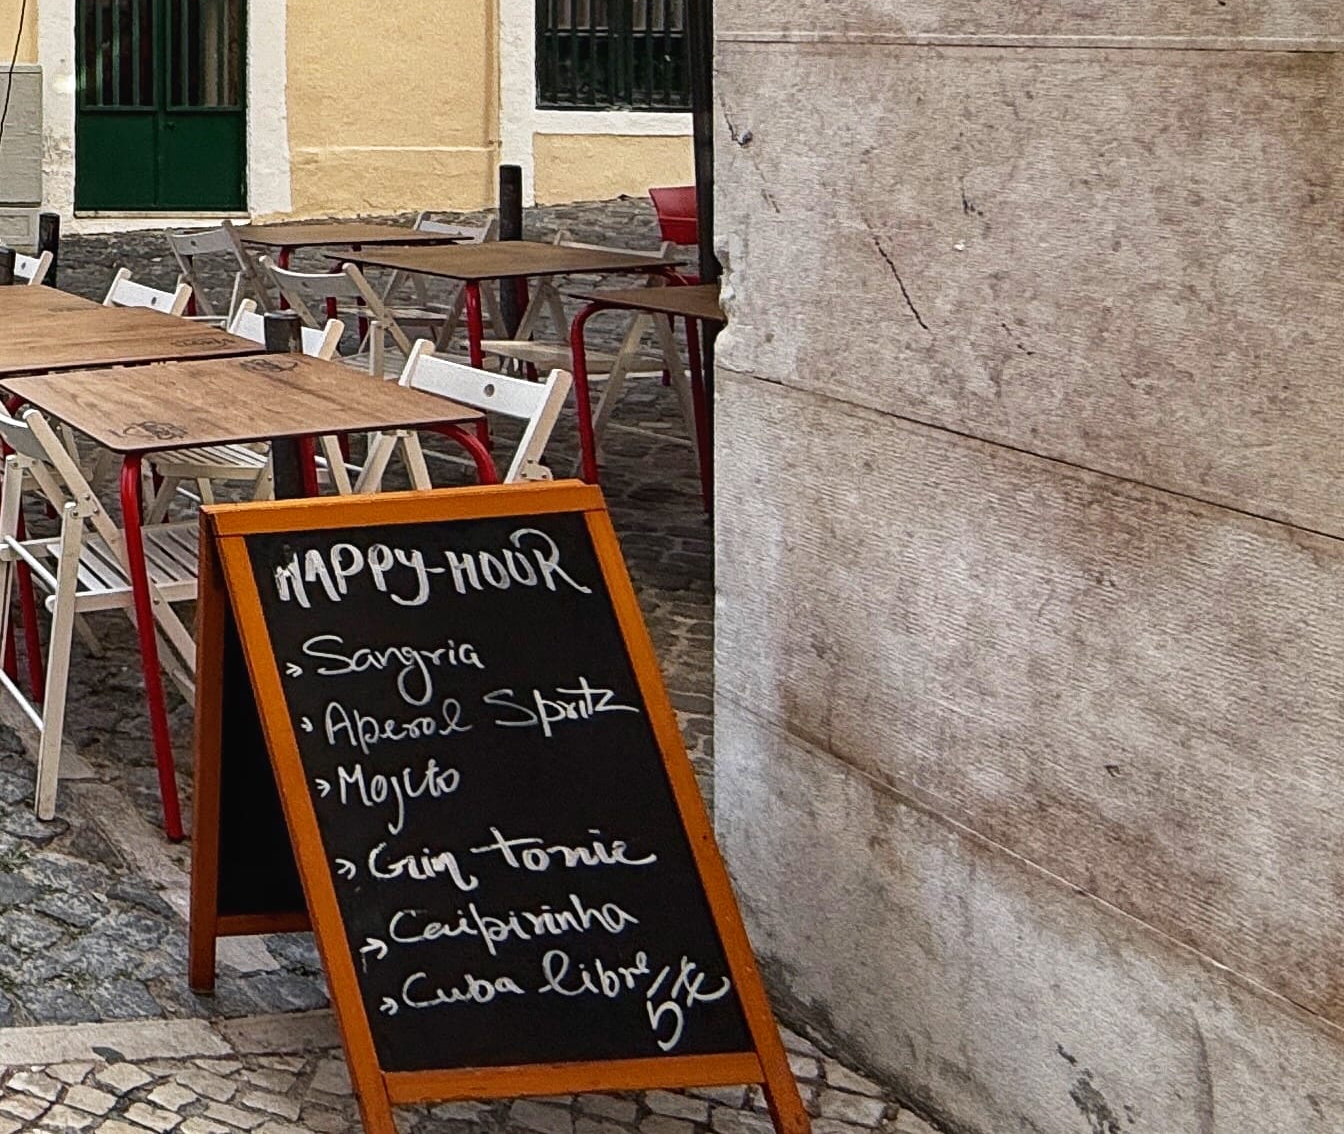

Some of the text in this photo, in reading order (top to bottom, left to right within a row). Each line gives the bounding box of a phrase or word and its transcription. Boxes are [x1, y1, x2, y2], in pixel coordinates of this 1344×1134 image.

[302, 634, 485, 706] Sangria
[325, 677, 639, 754] Aperol Spritz
[337, 758, 460, 835] Mojito
[368, 827, 657, 891] Gin tonic
[402, 949, 650, 1008] Cuba libre
